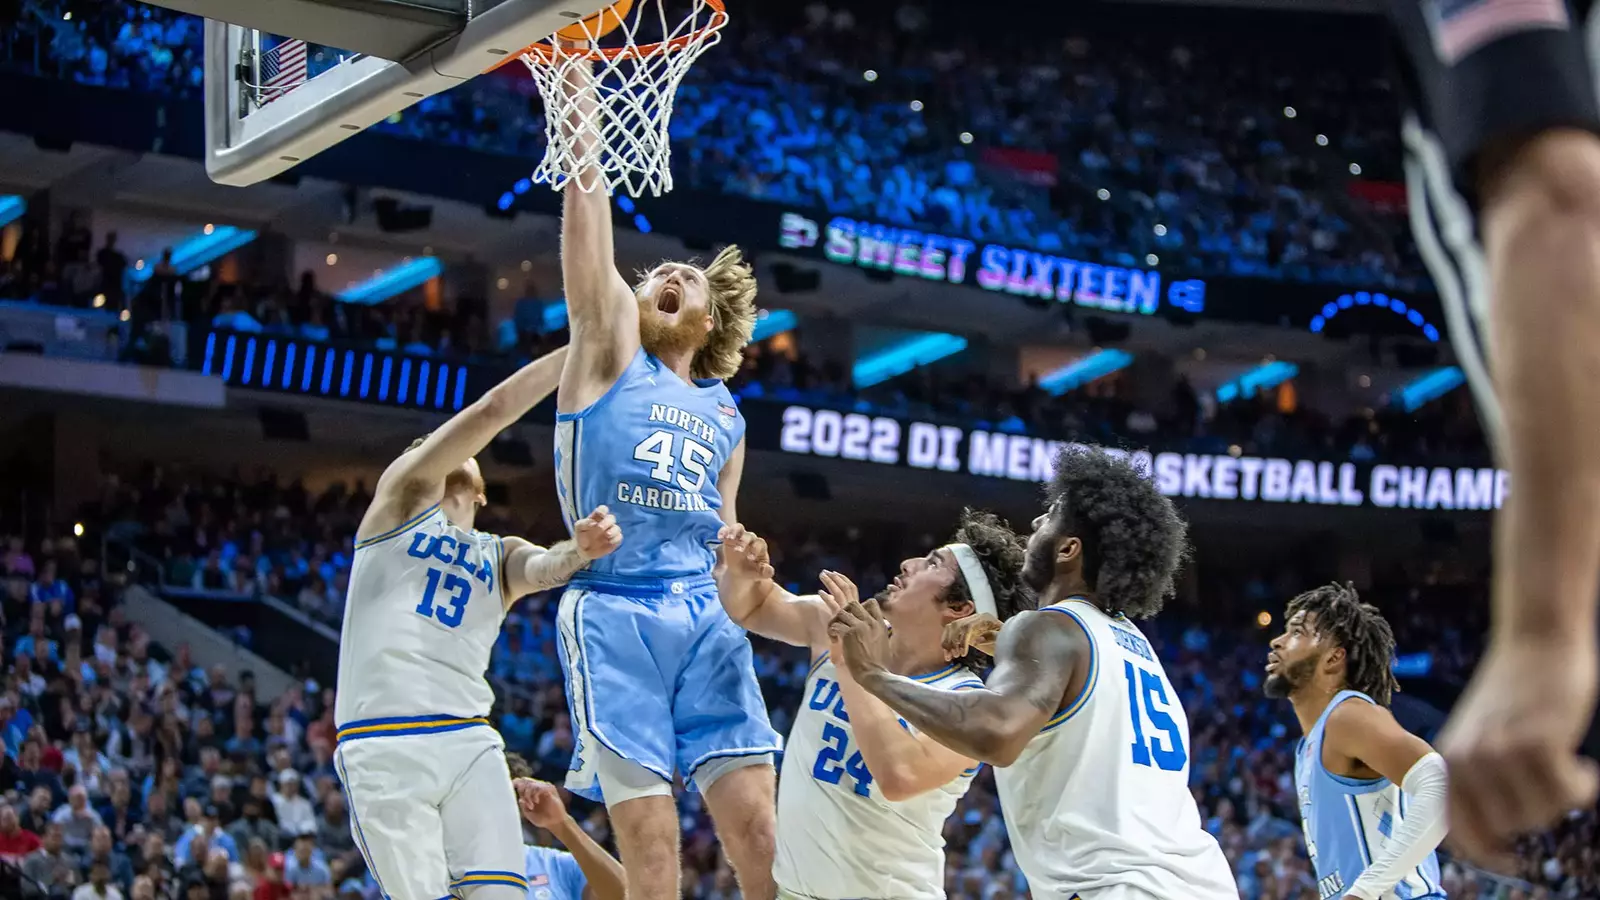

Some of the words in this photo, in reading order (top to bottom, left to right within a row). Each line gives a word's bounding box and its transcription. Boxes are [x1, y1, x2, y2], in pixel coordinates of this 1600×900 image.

[824, 215, 976, 283] SWEET
[977, 244, 1161, 314] SIXTEEN
[649, 403, 716, 445] NORTH
[781, 405, 900, 464] 2022
[907, 421, 963, 472] DI
[1103, 447, 1363, 506] ASKETBALL
[633, 430, 715, 493] 45
[617, 481, 709, 512] CAROLIN
[407, 532, 494, 595] UCLA
[415, 567, 472, 629] 13
[1123, 659, 1188, 772] 15
[813, 721, 874, 799] 24
